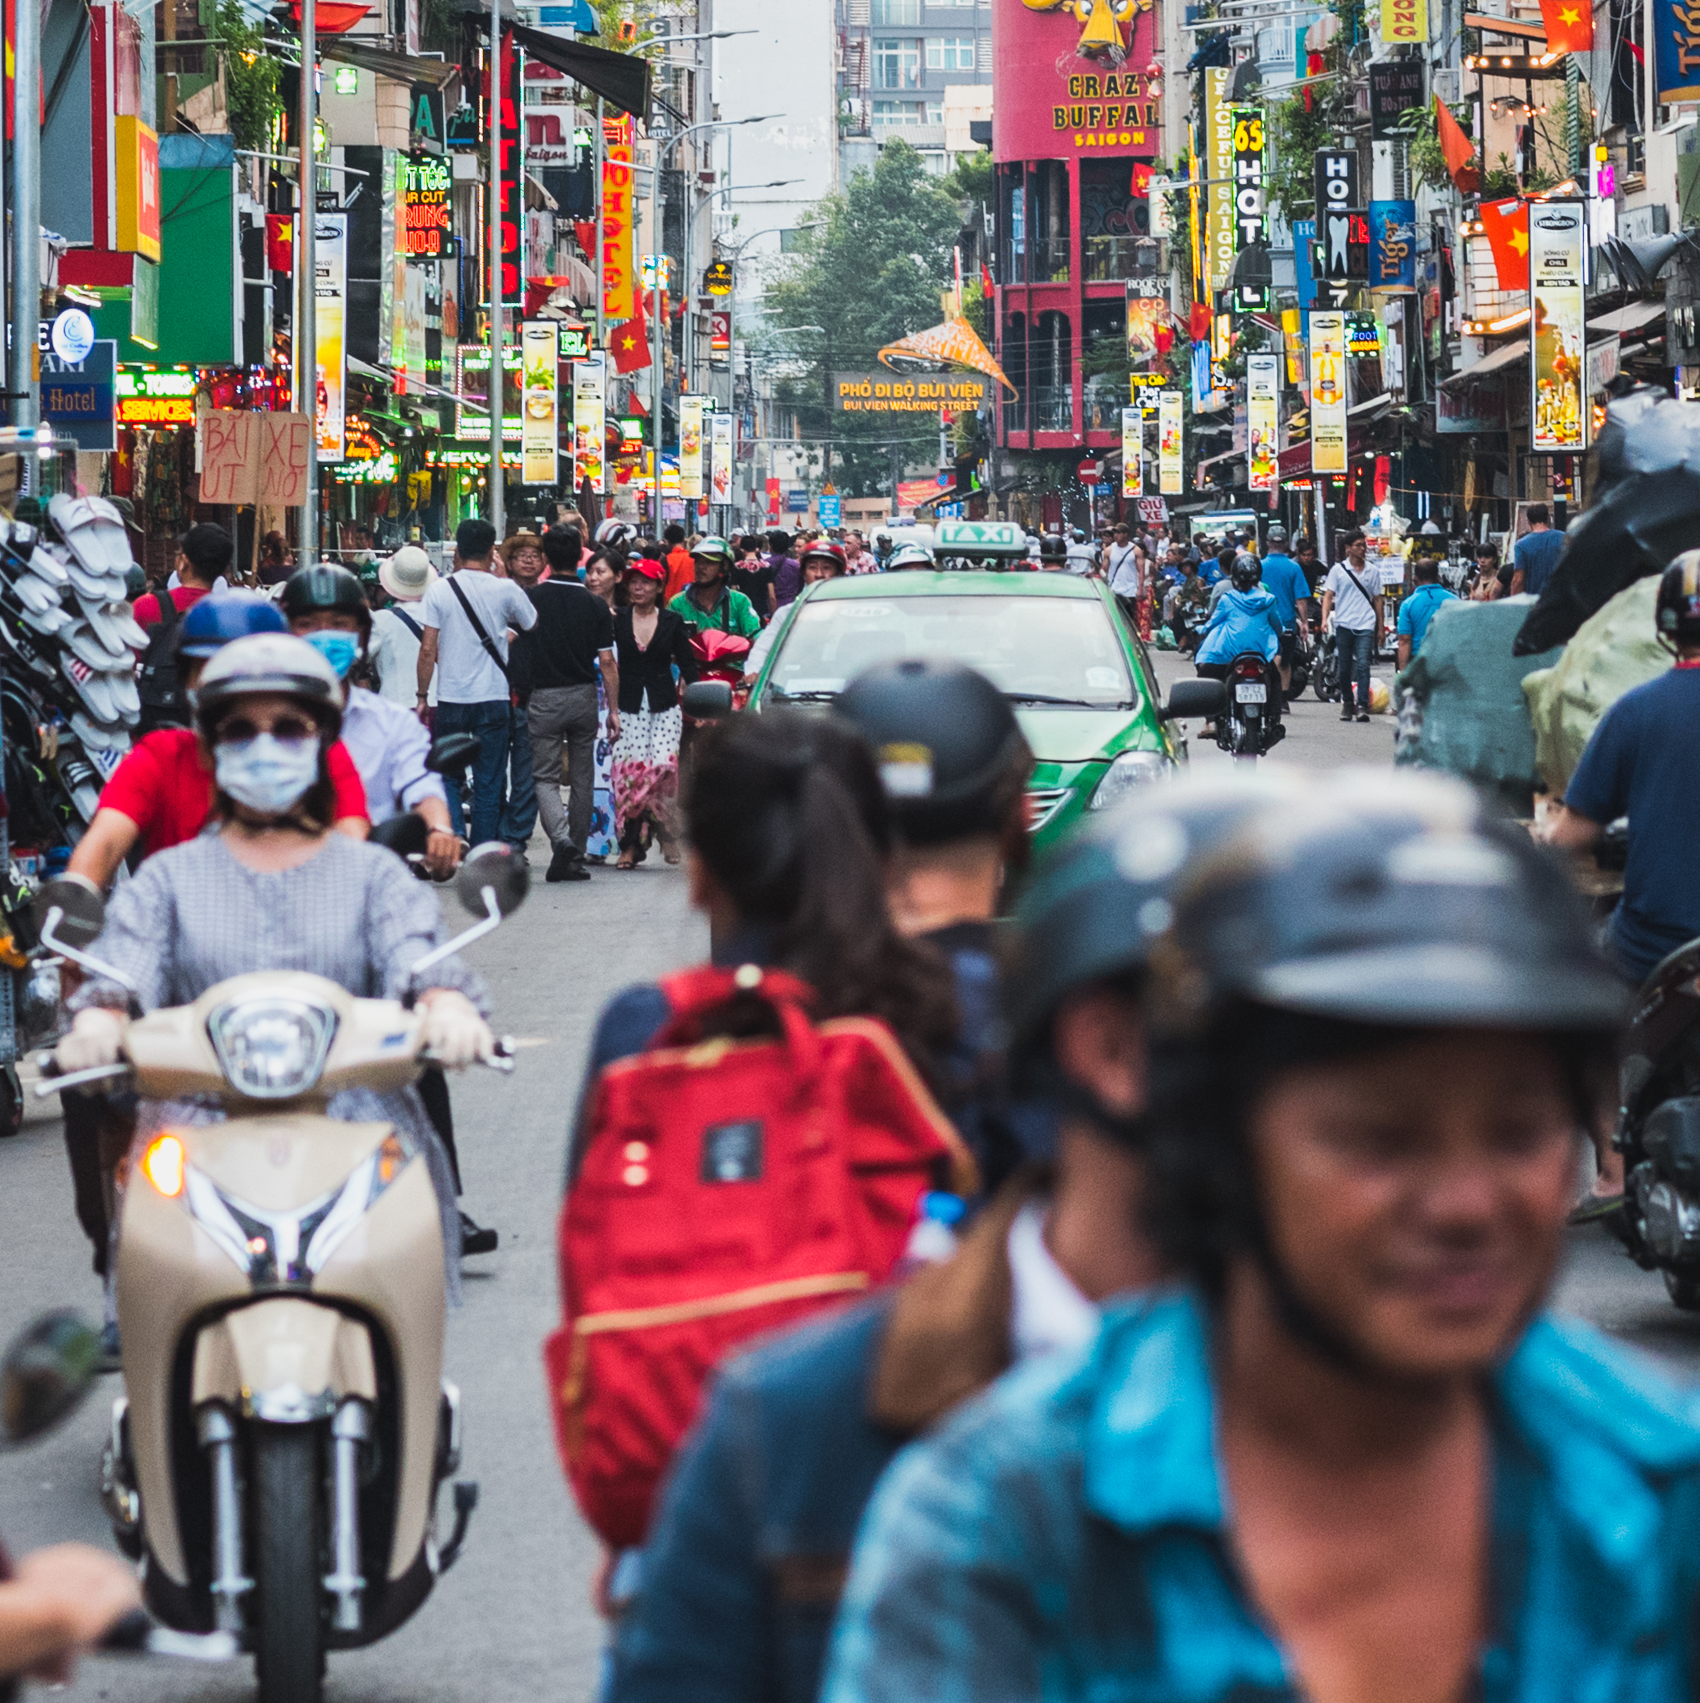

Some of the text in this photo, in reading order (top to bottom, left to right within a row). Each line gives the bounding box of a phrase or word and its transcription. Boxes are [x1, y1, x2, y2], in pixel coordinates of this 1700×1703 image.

[1068, 73, 1150, 98] CRAZ
[1074, 132, 1145, 147] SAIGON
[1234, 120, 1264, 152] 65
[420, 191, 445, 203] CUT
[487, 96, 518, 295] ATTOO
[1216, 186, 1233, 274] SAIGON
[1237, 160, 1262, 303] HOTL
[1537, 219, 1576, 228] STRONGBOW
[602, 191, 628, 314] HOTEL
[1379, 219, 1409, 280] Tiger
[1139, 286, 1164, 297] BBQ
[1353, 331, 1378, 341] FOOT
[51, 387, 96, 412] Hotel
[839, 375, 984, 402] PHỐ ĐI BỘ BÙI VIỆN
[1139, 386, 1160, 398] Bar
[121, 400, 192, 421] SERVICES
[843, 400, 979, 411] BUI VIEN WALKING STREET
[265, 421, 310, 468] XE
[1144, 510, 1163, 520] XE
[943, 525, 1013, 545] TAXI
